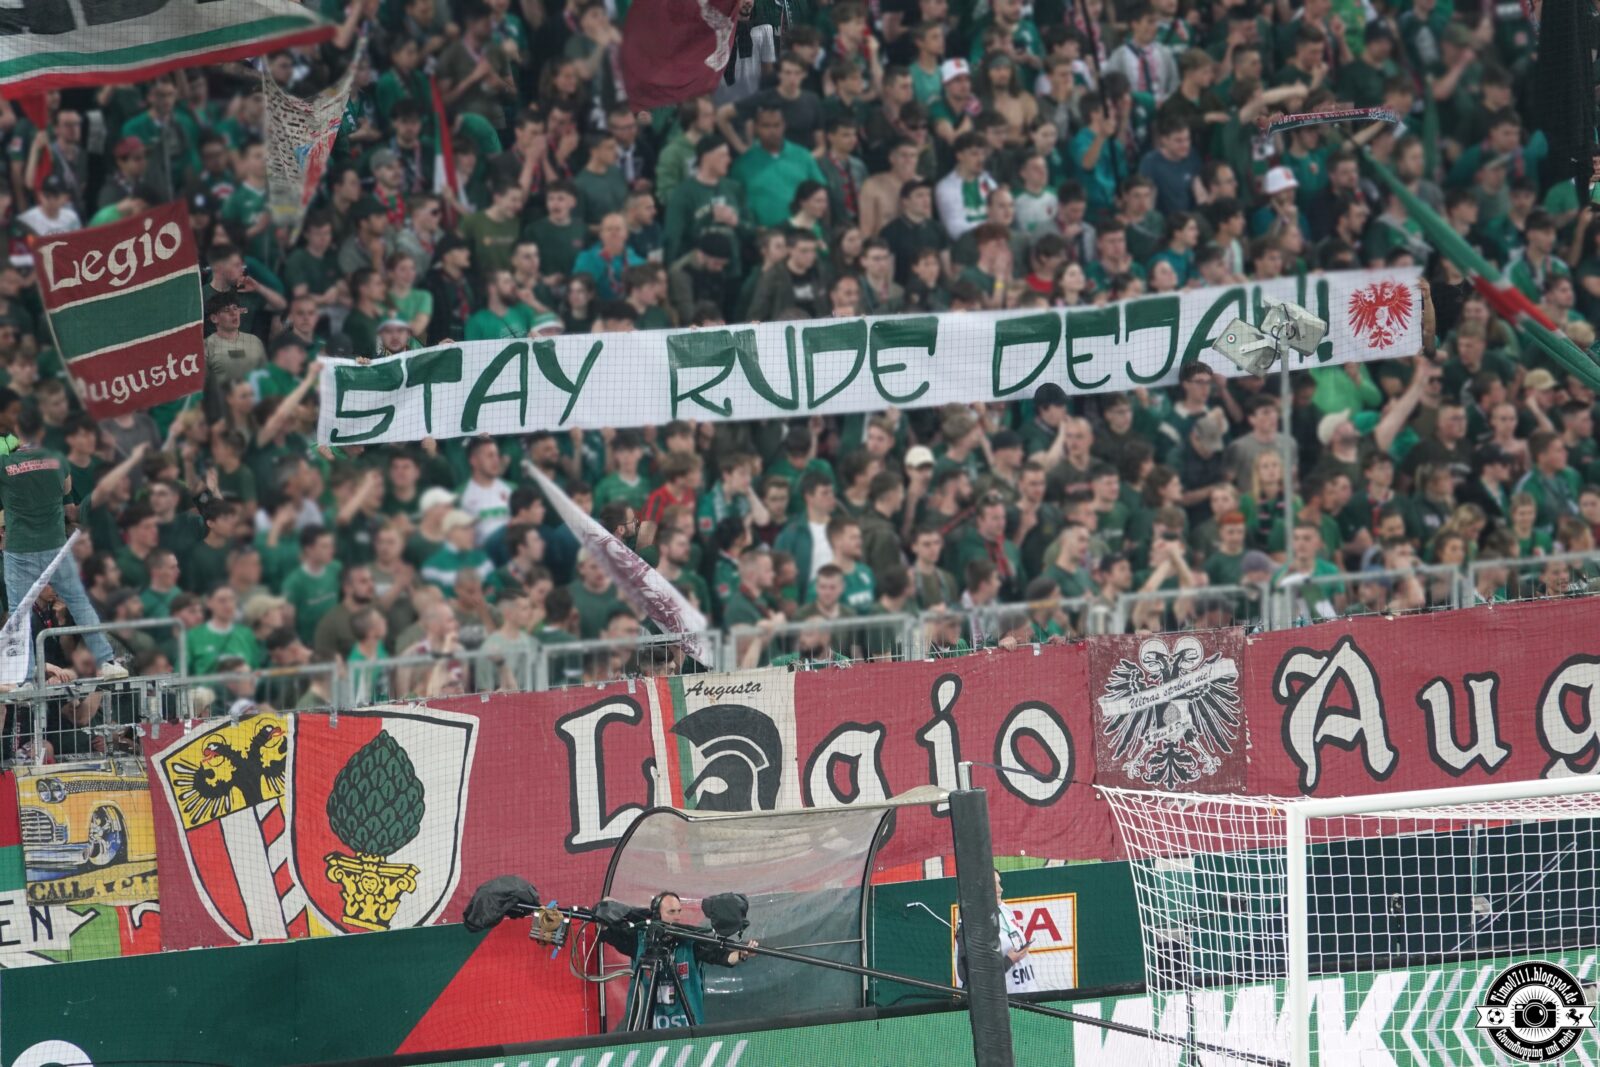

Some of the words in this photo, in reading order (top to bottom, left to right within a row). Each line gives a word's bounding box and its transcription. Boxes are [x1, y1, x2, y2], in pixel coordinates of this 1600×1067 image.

[38, 218, 182, 293] Legio
[330, 339, 604, 443] STAY
[666, 316, 939, 419] RUDE
[684, 680, 763, 700] Augusta
[1128, 692, 1160, 709] Ultras
[1195, 665, 1214, 684] nie!
[554, 672, 1075, 854] Lgio
[29, 880, 95, 901] CALL
